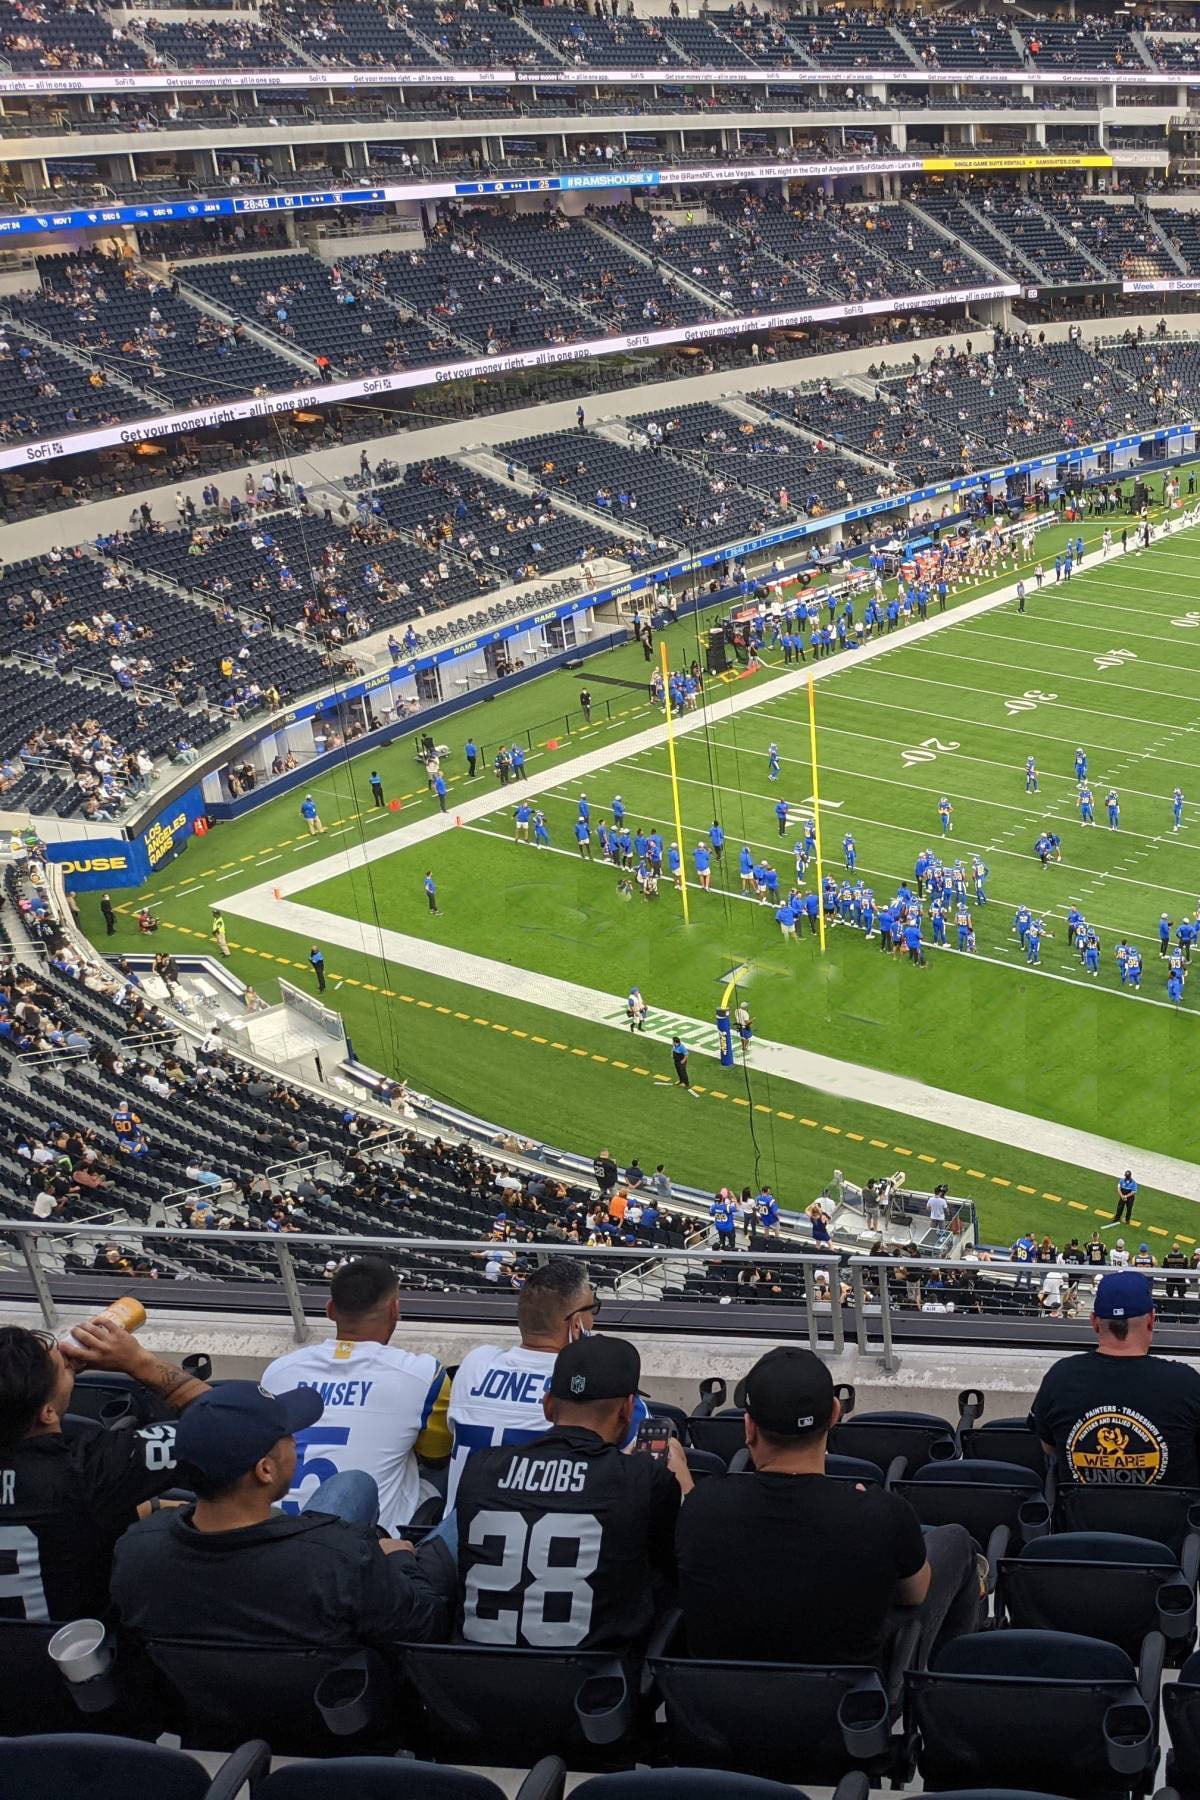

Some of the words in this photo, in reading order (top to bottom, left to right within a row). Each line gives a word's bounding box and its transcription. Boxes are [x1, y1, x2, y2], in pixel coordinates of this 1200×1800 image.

[568, 174, 643, 187] #RAMSHOUSE
[243, 200, 270, 209] 28:46
[1133, 282, 1155, 290] Week
[685, 330, 698, 340] Get
[699, 327, 715, 337] your
[717, 325, 739, 336] money
[741, 321, 758, 332] right
[626, 336, 642, 346] SoFi
[435, 370, 452, 382] Get
[453, 366, 472, 378] your
[474, 363, 502, 375] money
[504, 357, 524, 371] right
[536, 354, 546, 364] all
[557, 350, 573, 360] one
[363, 380, 382, 393] SoFi
[120, 429, 141, 443] Get
[143, 425, 168, 439] your
[170, 418, 208, 435] money
[209, 407, 235, 423] right
[249, 403, 262, 417] all
[263, 402, 274, 414] in
[276, 400, 295, 411] one
[27, 444, 51, 460] SoFi
[611, 584, 632, 597] RAMS
[534, 611, 557, 625] RAMS
[453, 640, 477, 655] RAMS
[364, 674, 390, 690] RAMS
[1004, 689, 1058, 711] 30
[901, 737, 960, 762] 20
[144, 822, 162, 845] LOS
[147, 813, 187, 855] ANGELES
[149, 837, 174, 866] RAMS
[114, 1120, 132, 1132] 80
[1085, 1405, 1117, 1419] PAINTERS
[1122, 1407, 1160, 1436] TRADESHOW
[1079, 1422, 1099, 1441] PAINTERS
[1099, 1417, 1111, 1425] AND
[1111, 1418, 1131, 1428] ALLIED
[1131, 1425, 1150, 1443] TRADES
[1084, 1455, 1109, 1468] WE
[1114, 1455, 1146, 1468] ARE
[498, 1455, 588, 1492] JACOBS
[1086, 1467, 1146, 1484] UNION
[463, 1510, 603, 1647] 28
